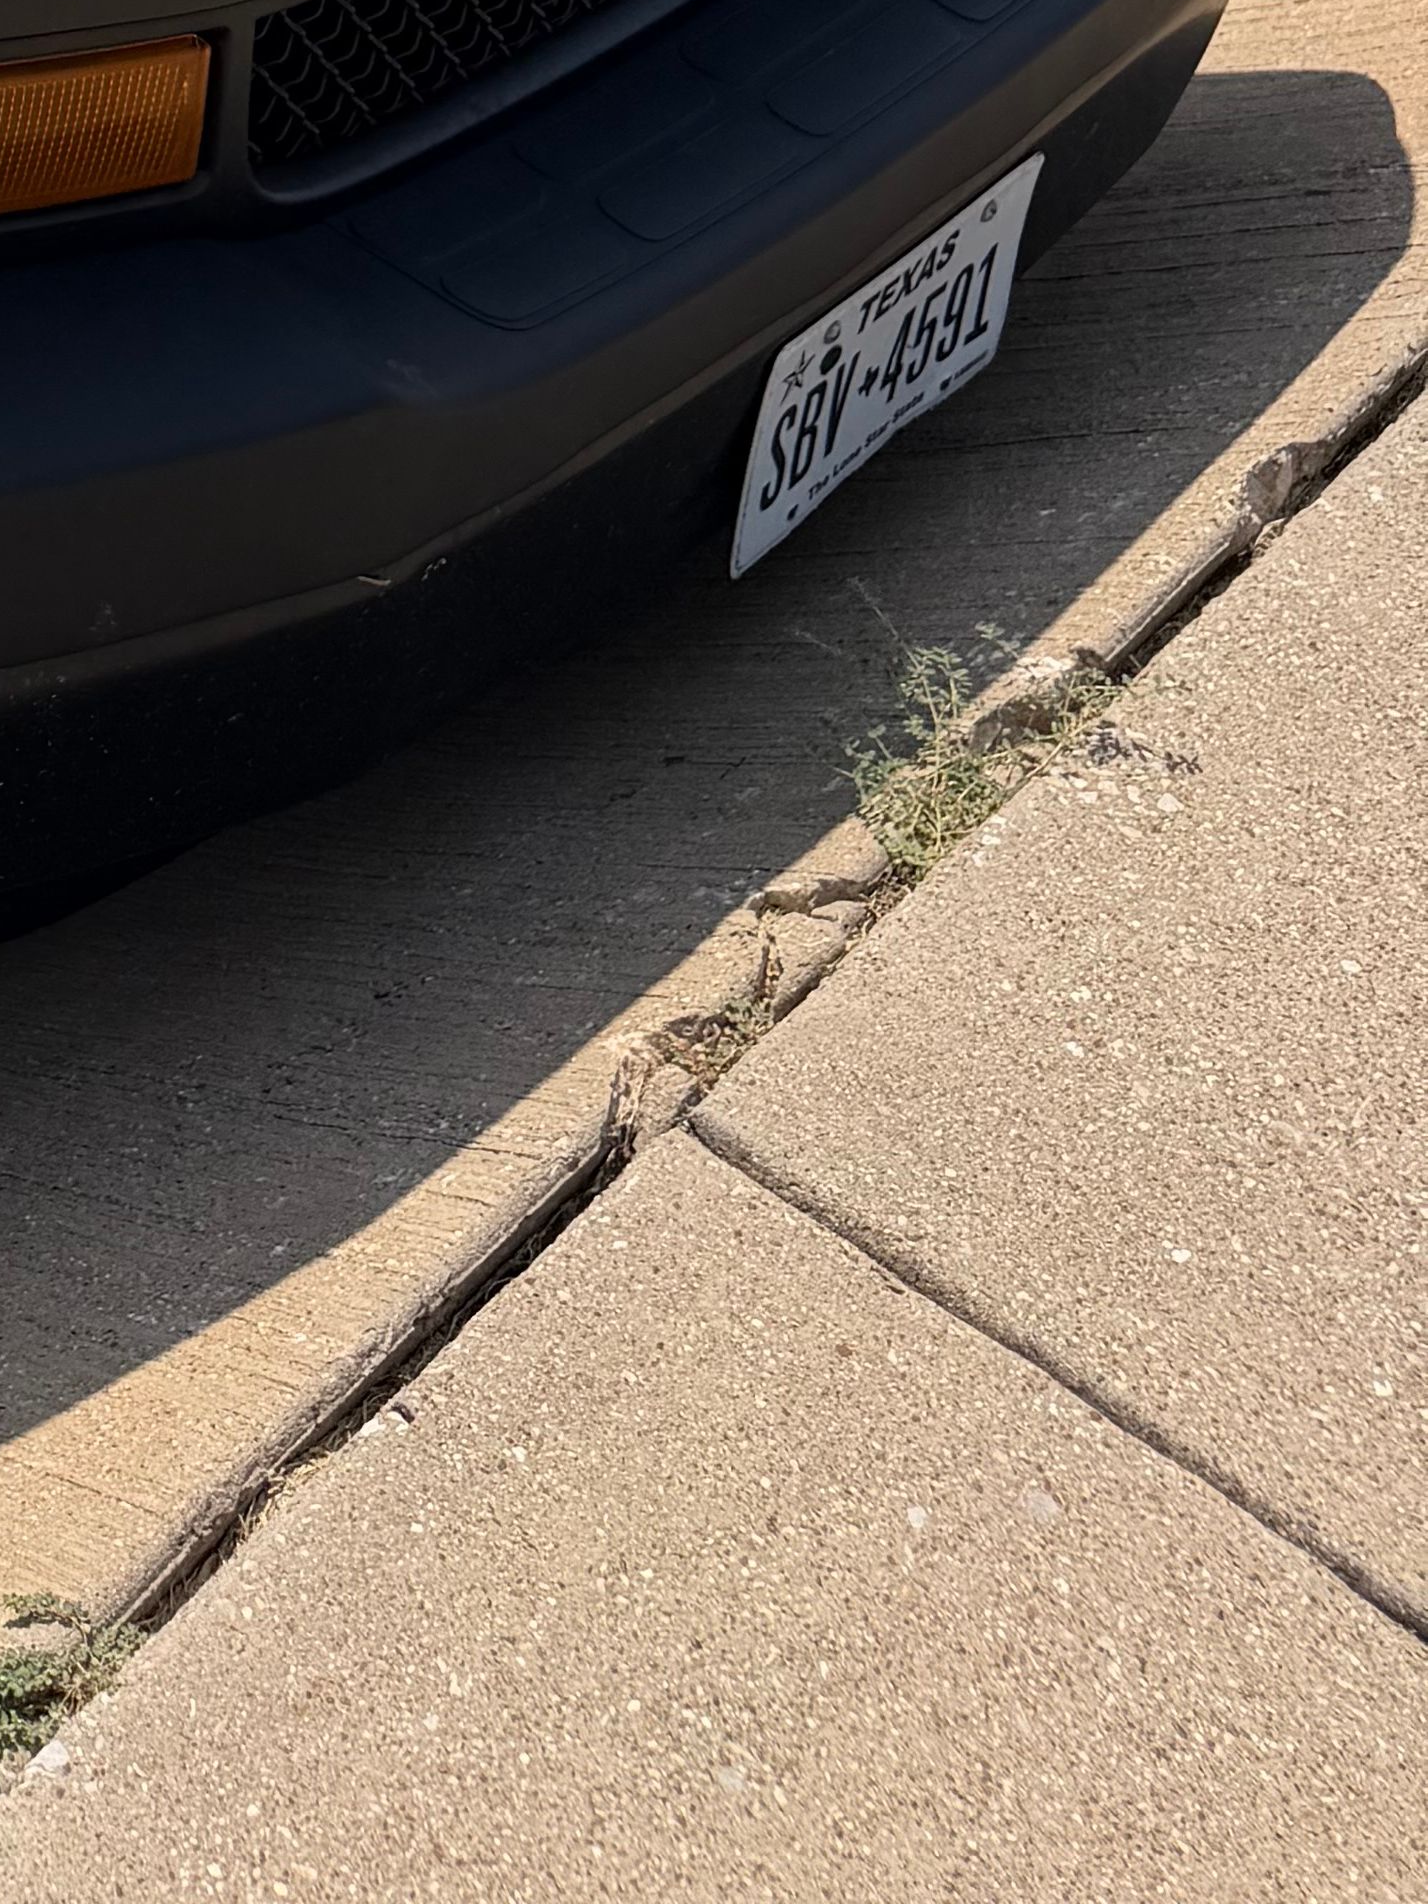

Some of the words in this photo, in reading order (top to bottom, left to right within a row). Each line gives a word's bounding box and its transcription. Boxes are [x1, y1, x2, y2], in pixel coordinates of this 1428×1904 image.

[855, 228, 961, 335] TEXAS
[808, 474, 830, 500] The
[832, 445, 863, 478] Lone
[863, 420, 892, 449] Star
[891, 391, 925, 424] State
